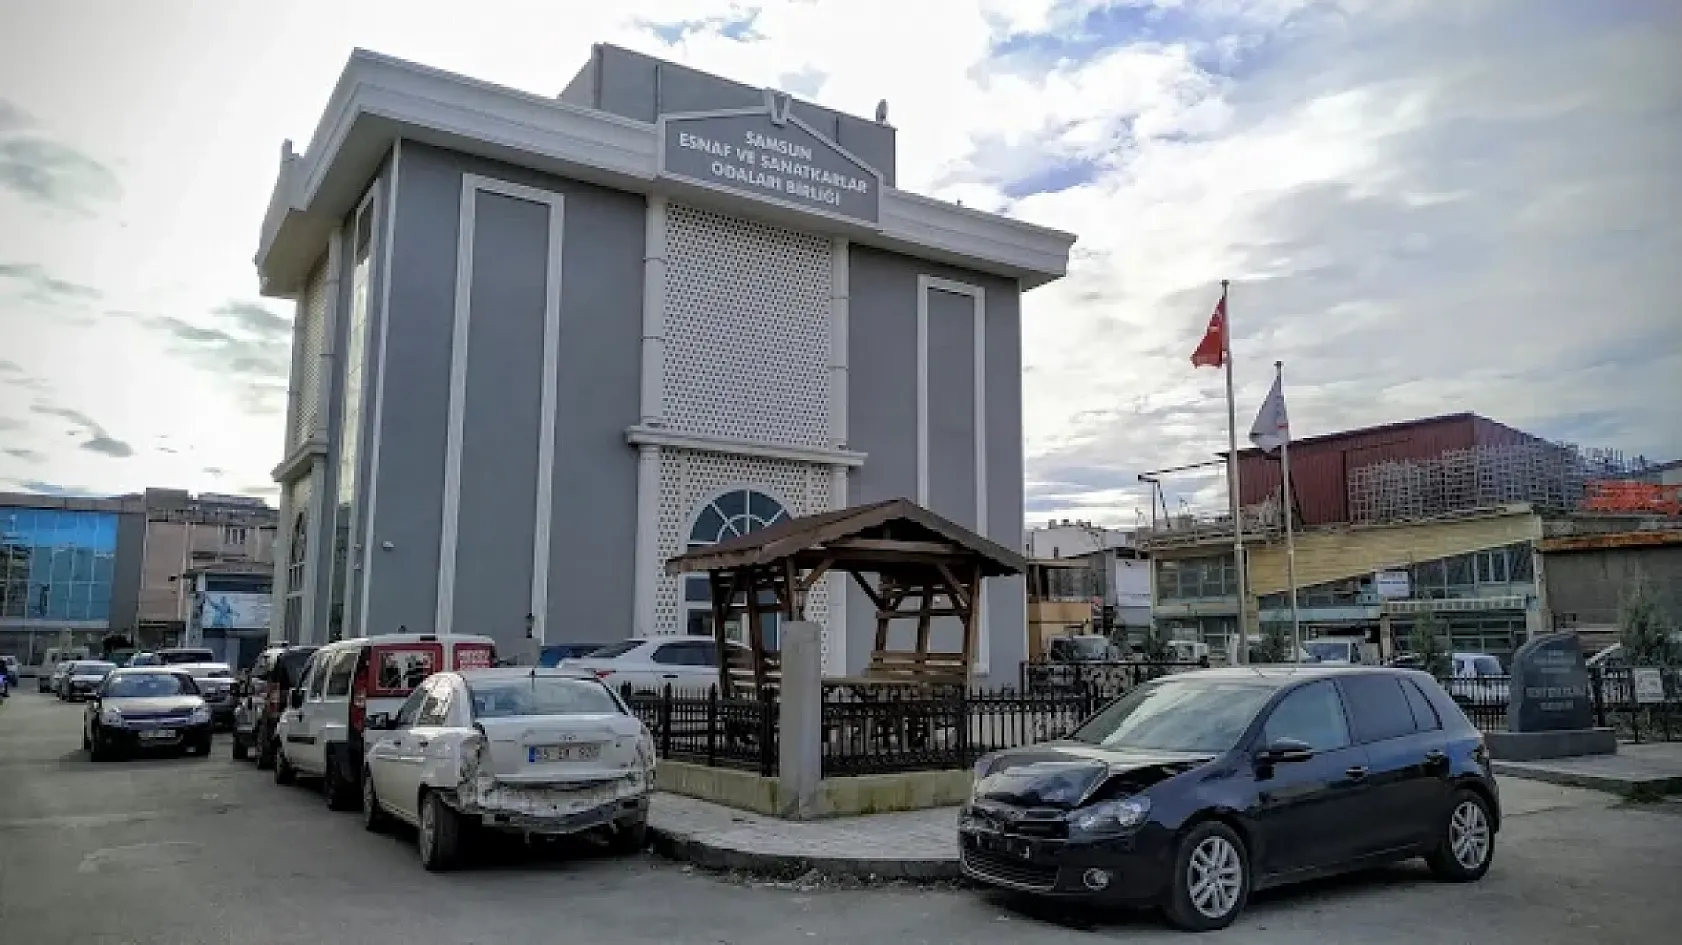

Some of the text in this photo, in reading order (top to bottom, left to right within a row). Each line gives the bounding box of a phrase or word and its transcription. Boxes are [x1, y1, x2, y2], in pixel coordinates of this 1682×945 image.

[745, 130, 812, 161] SAMSUN
[679, 131, 867, 194] ESNAF VE SANATKARLAR
[711, 160, 782, 191] ODALARI
